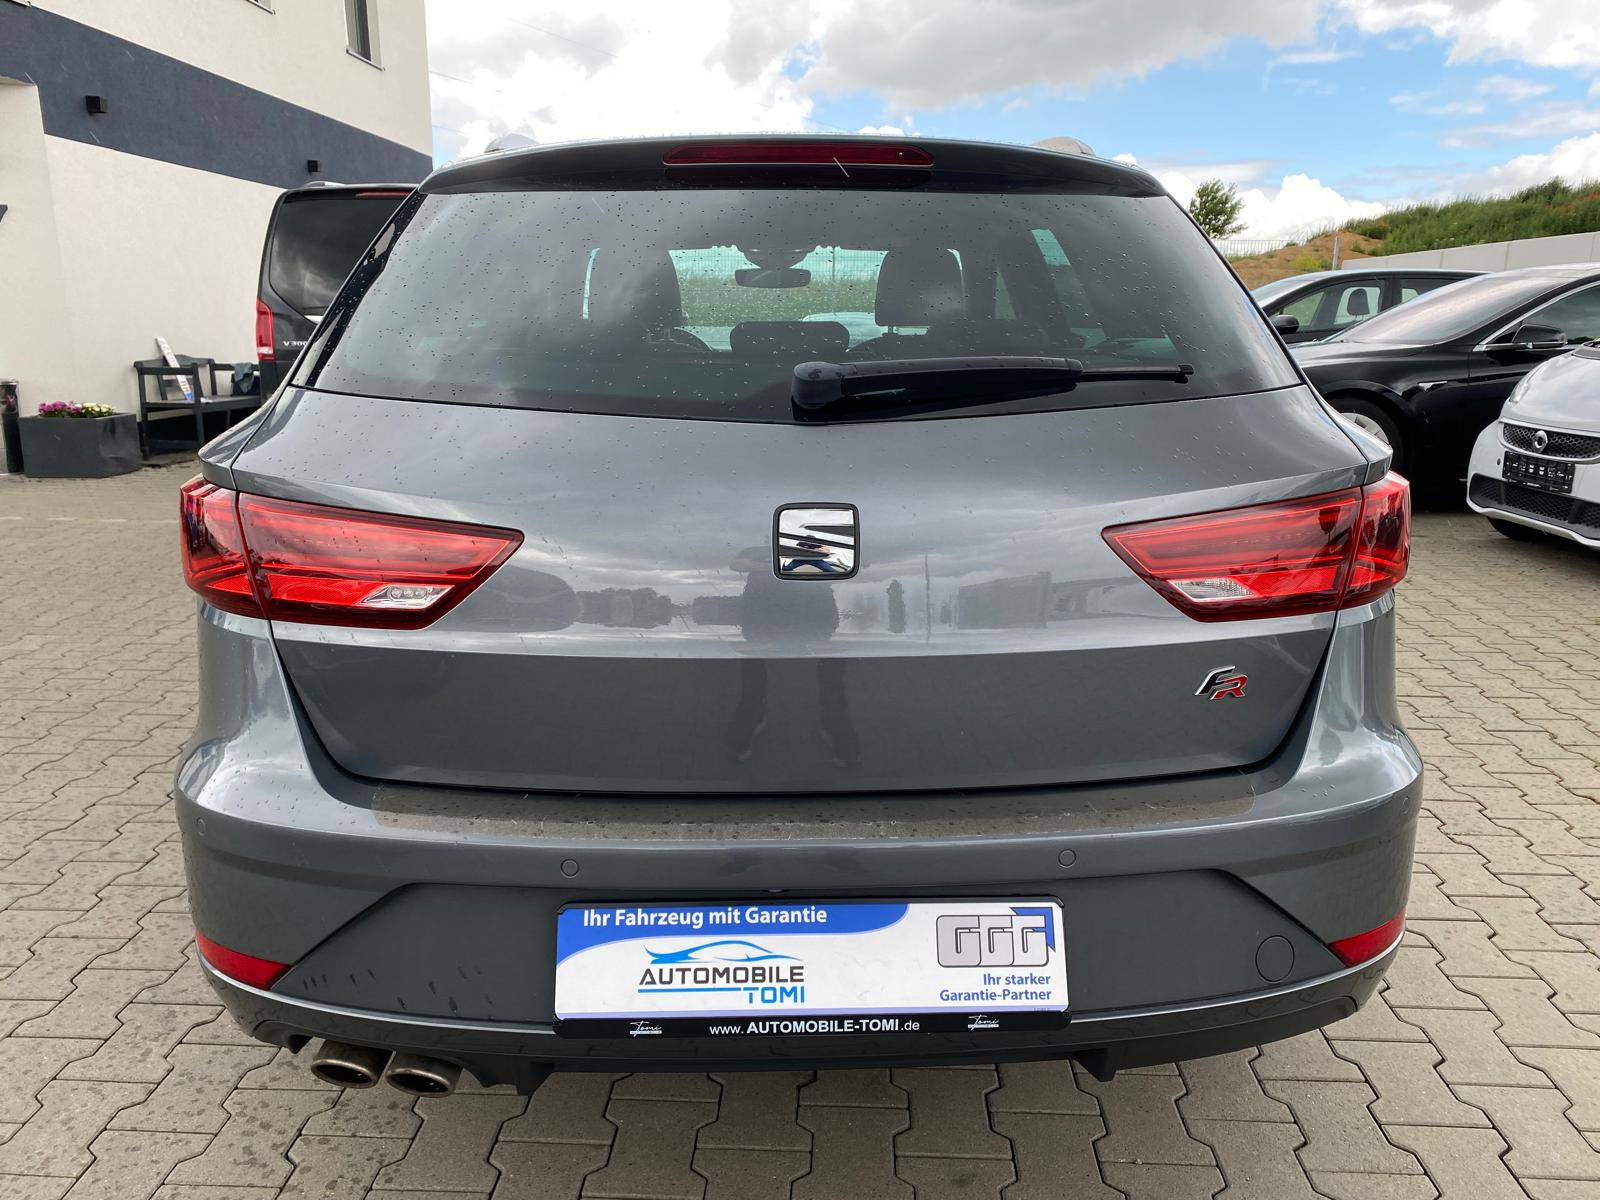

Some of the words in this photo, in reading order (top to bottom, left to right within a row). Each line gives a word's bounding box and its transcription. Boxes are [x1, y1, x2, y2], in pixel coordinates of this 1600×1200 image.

[1194, 665, 1248, 700] FR
[583, 910, 611, 927] Ihr
[615, 908, 704, 929] Fahrzeug
[709, 907, 740, 925] mit
[745, 906, 827, 924] Garantie
[639, 965, 805, 986] AUTOMOBILE
[983, 973, 1002, 986] Ihr
[1005, 973, 1051, 985] starker
[742, 986, 805, 1004] TOMI
[940, 988, 1052, 1001] Garantie-Partner
